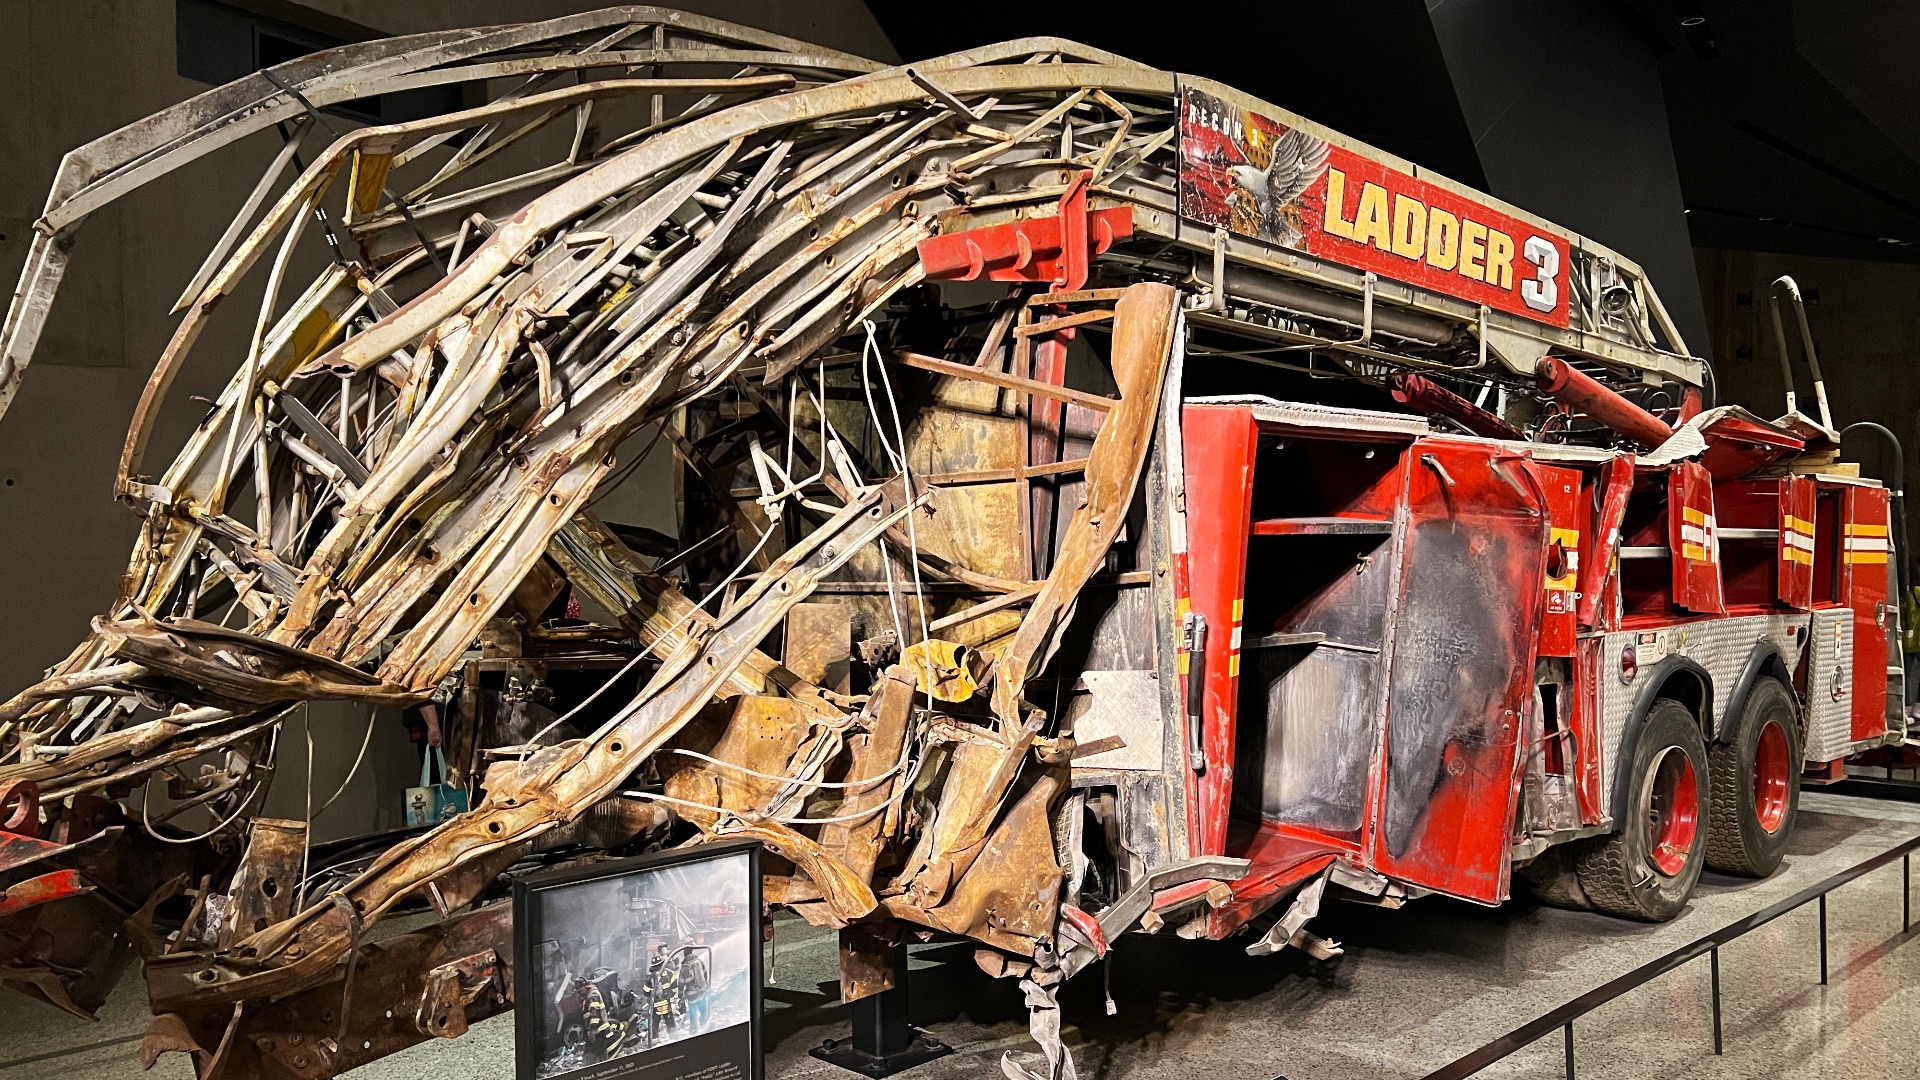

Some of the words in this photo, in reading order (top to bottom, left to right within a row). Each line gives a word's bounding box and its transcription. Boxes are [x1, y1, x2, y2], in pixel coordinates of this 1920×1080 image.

[1189, 103, 1242, 140] RECON
[1252, 128, 1258, 146] 3
[1323, 166, 1515, 291] LADDER
[1521, 233, 1560, 313] 3
[1564, 485, 1570, 493] 12
